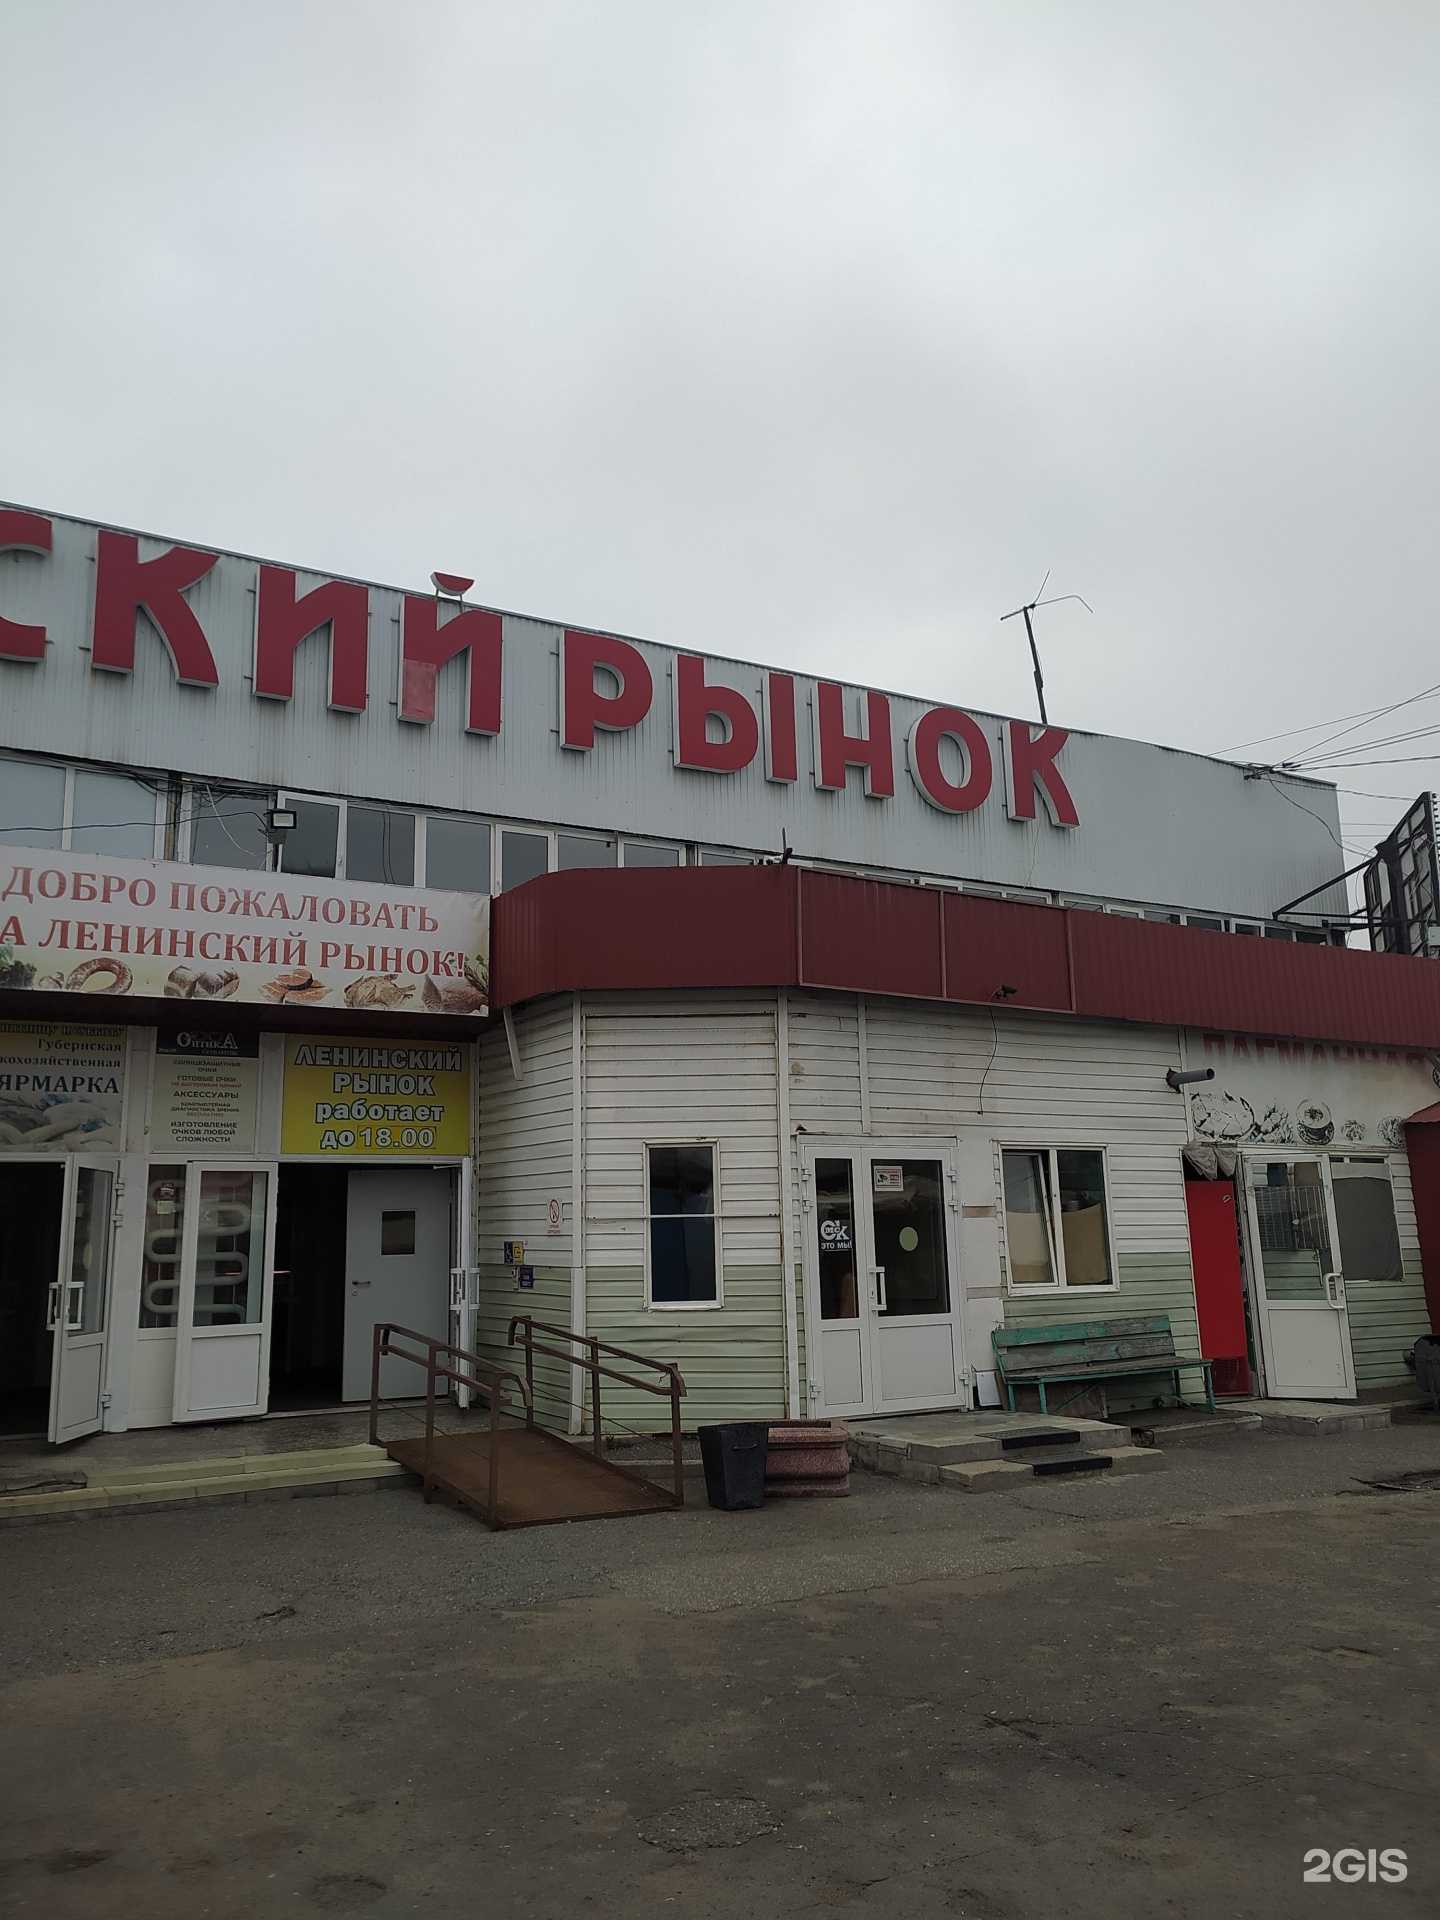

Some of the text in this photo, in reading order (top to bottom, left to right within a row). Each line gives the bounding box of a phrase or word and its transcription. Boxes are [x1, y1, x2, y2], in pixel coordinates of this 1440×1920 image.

[559, 629, 1081, 829] РЫНОК
[2, 866, 440, 933] ДОБРО ПОЖАЛОВАТЬ
[38, 918, 307, 967] ЛЕНИНСКИЙ
[319, 940, 466, 978] РЫНОК!
[38, 1038, 121, 1052] Губернская
[295, 1043, 463, 1072] ЛЕНИНСКИЙ
[0, 1073, 120, 1095] ЯРМАРКА
[173, 1091, 240, 1100] АКСЕССУАРЫ
[333, 1071, 436, 1097] РЫНОК
[315, 1097, 445, 1124] работает
[170, 1121, 238, 1129] ИЗГОТОВЛЕНИЕ
[171, 1128, 236, 1136] ОЧКОВ ЛЮБОЙ
[320, 1127, 434, 1150] до 18.00
